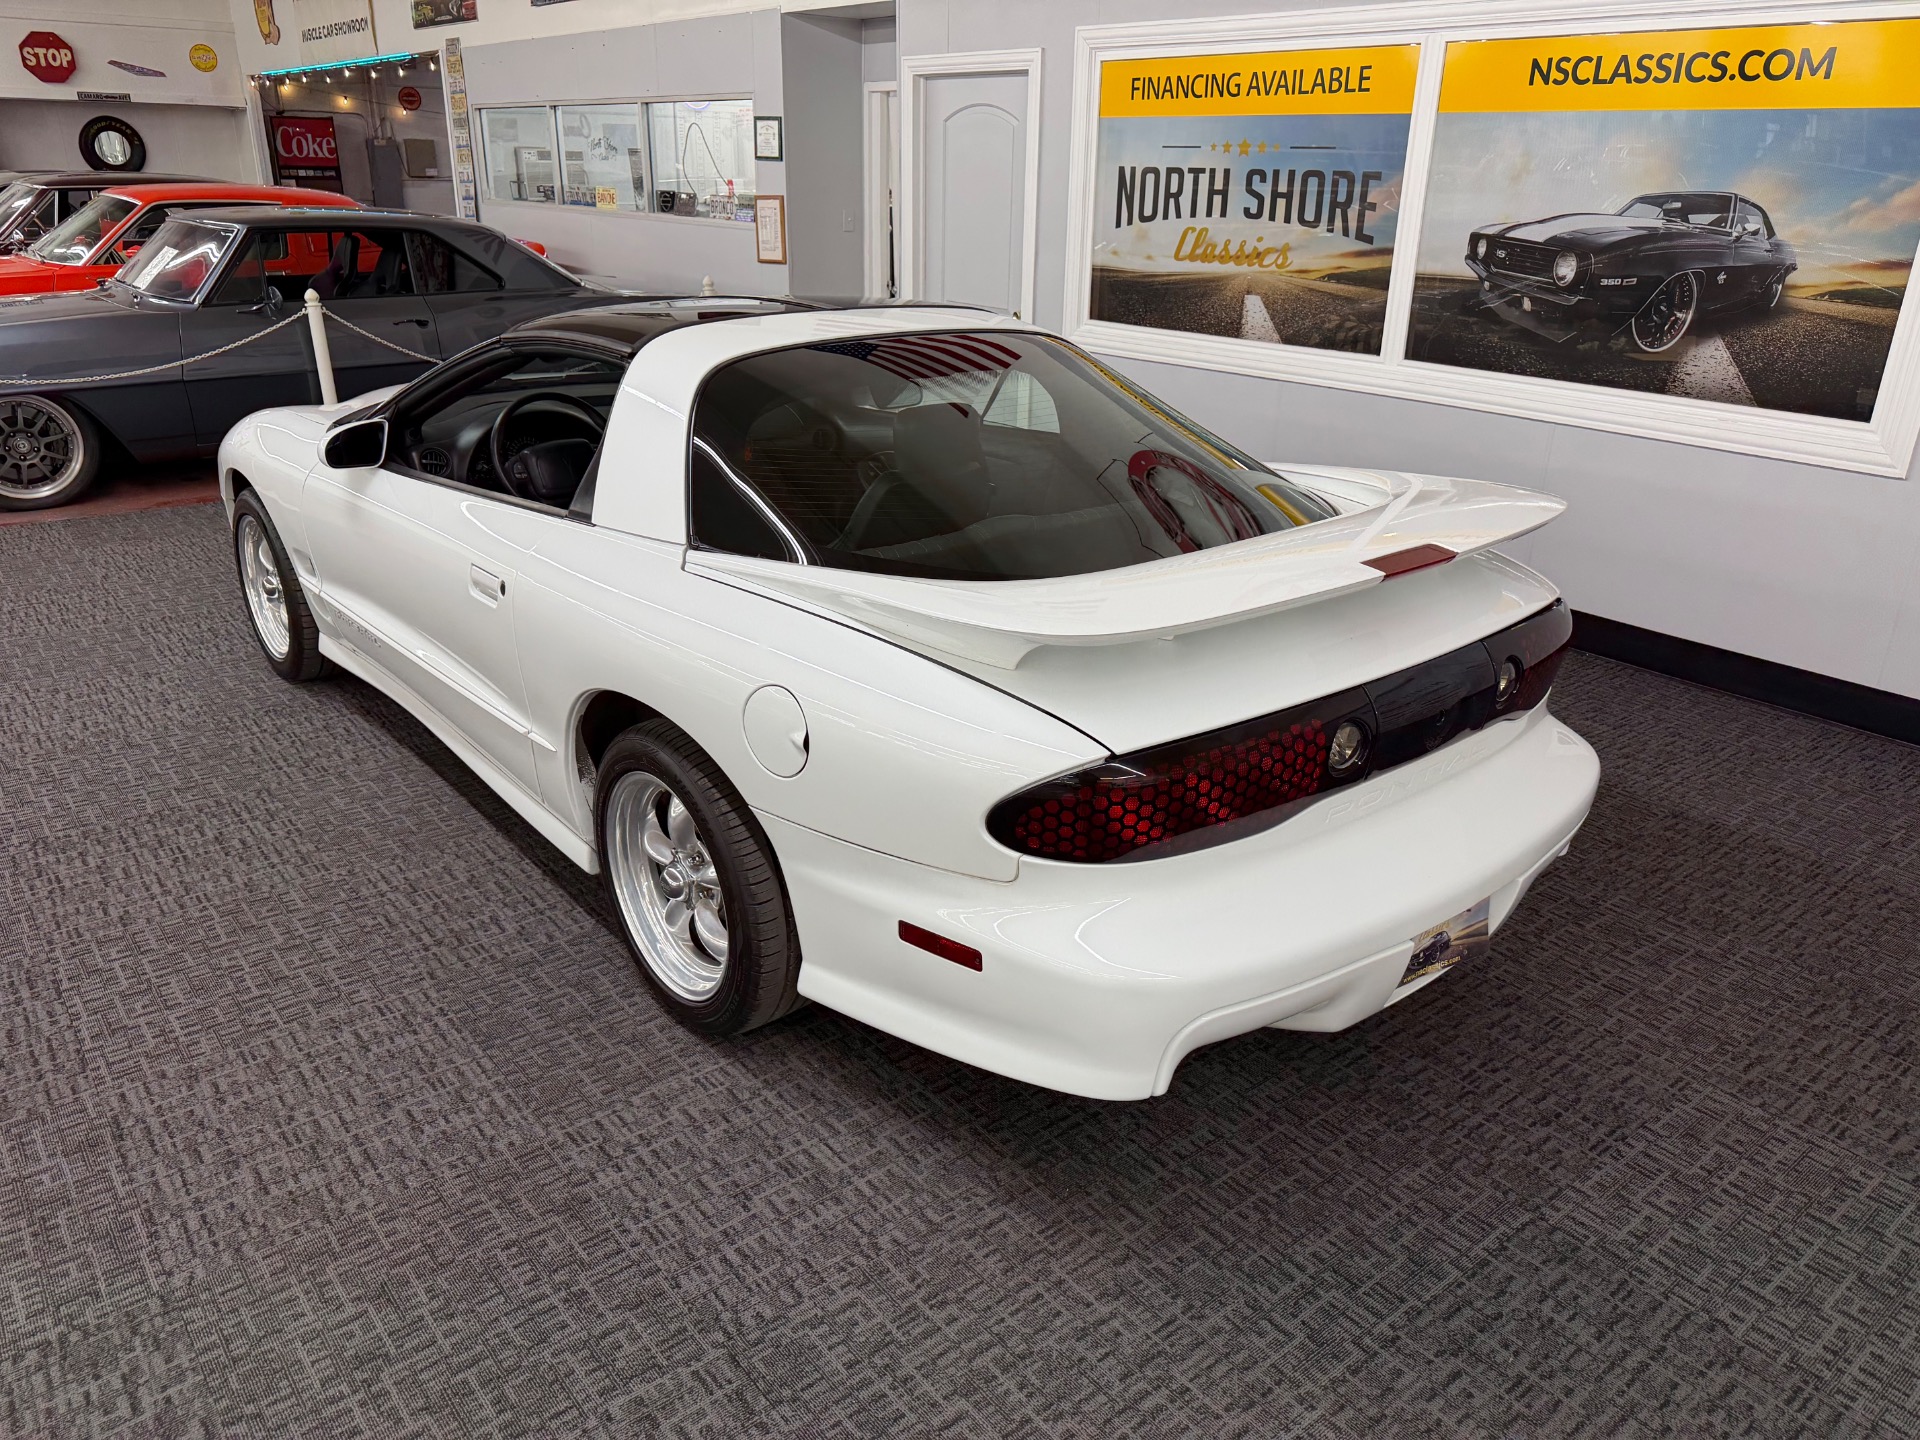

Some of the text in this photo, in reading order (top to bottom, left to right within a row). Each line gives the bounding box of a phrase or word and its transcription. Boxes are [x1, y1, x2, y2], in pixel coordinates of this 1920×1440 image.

[301, 17, 369, 43] MUSCLE CAR SHOWROOM
[22, 46, 73, 68] STOP
[1528, 46, 1838, 86] NSCLASSICS.COM
[1131, 64, 1373, 101] FINANCING AVAILABLE
[276, 125, 337, 159] Coke
[710, 198, 735, 216] BRONCO
[1115, 165, 1383, 246] NORTH SHORE
[1173, 225, 1294, 270] Classics
[1600, 277, 1622, 286] 350
